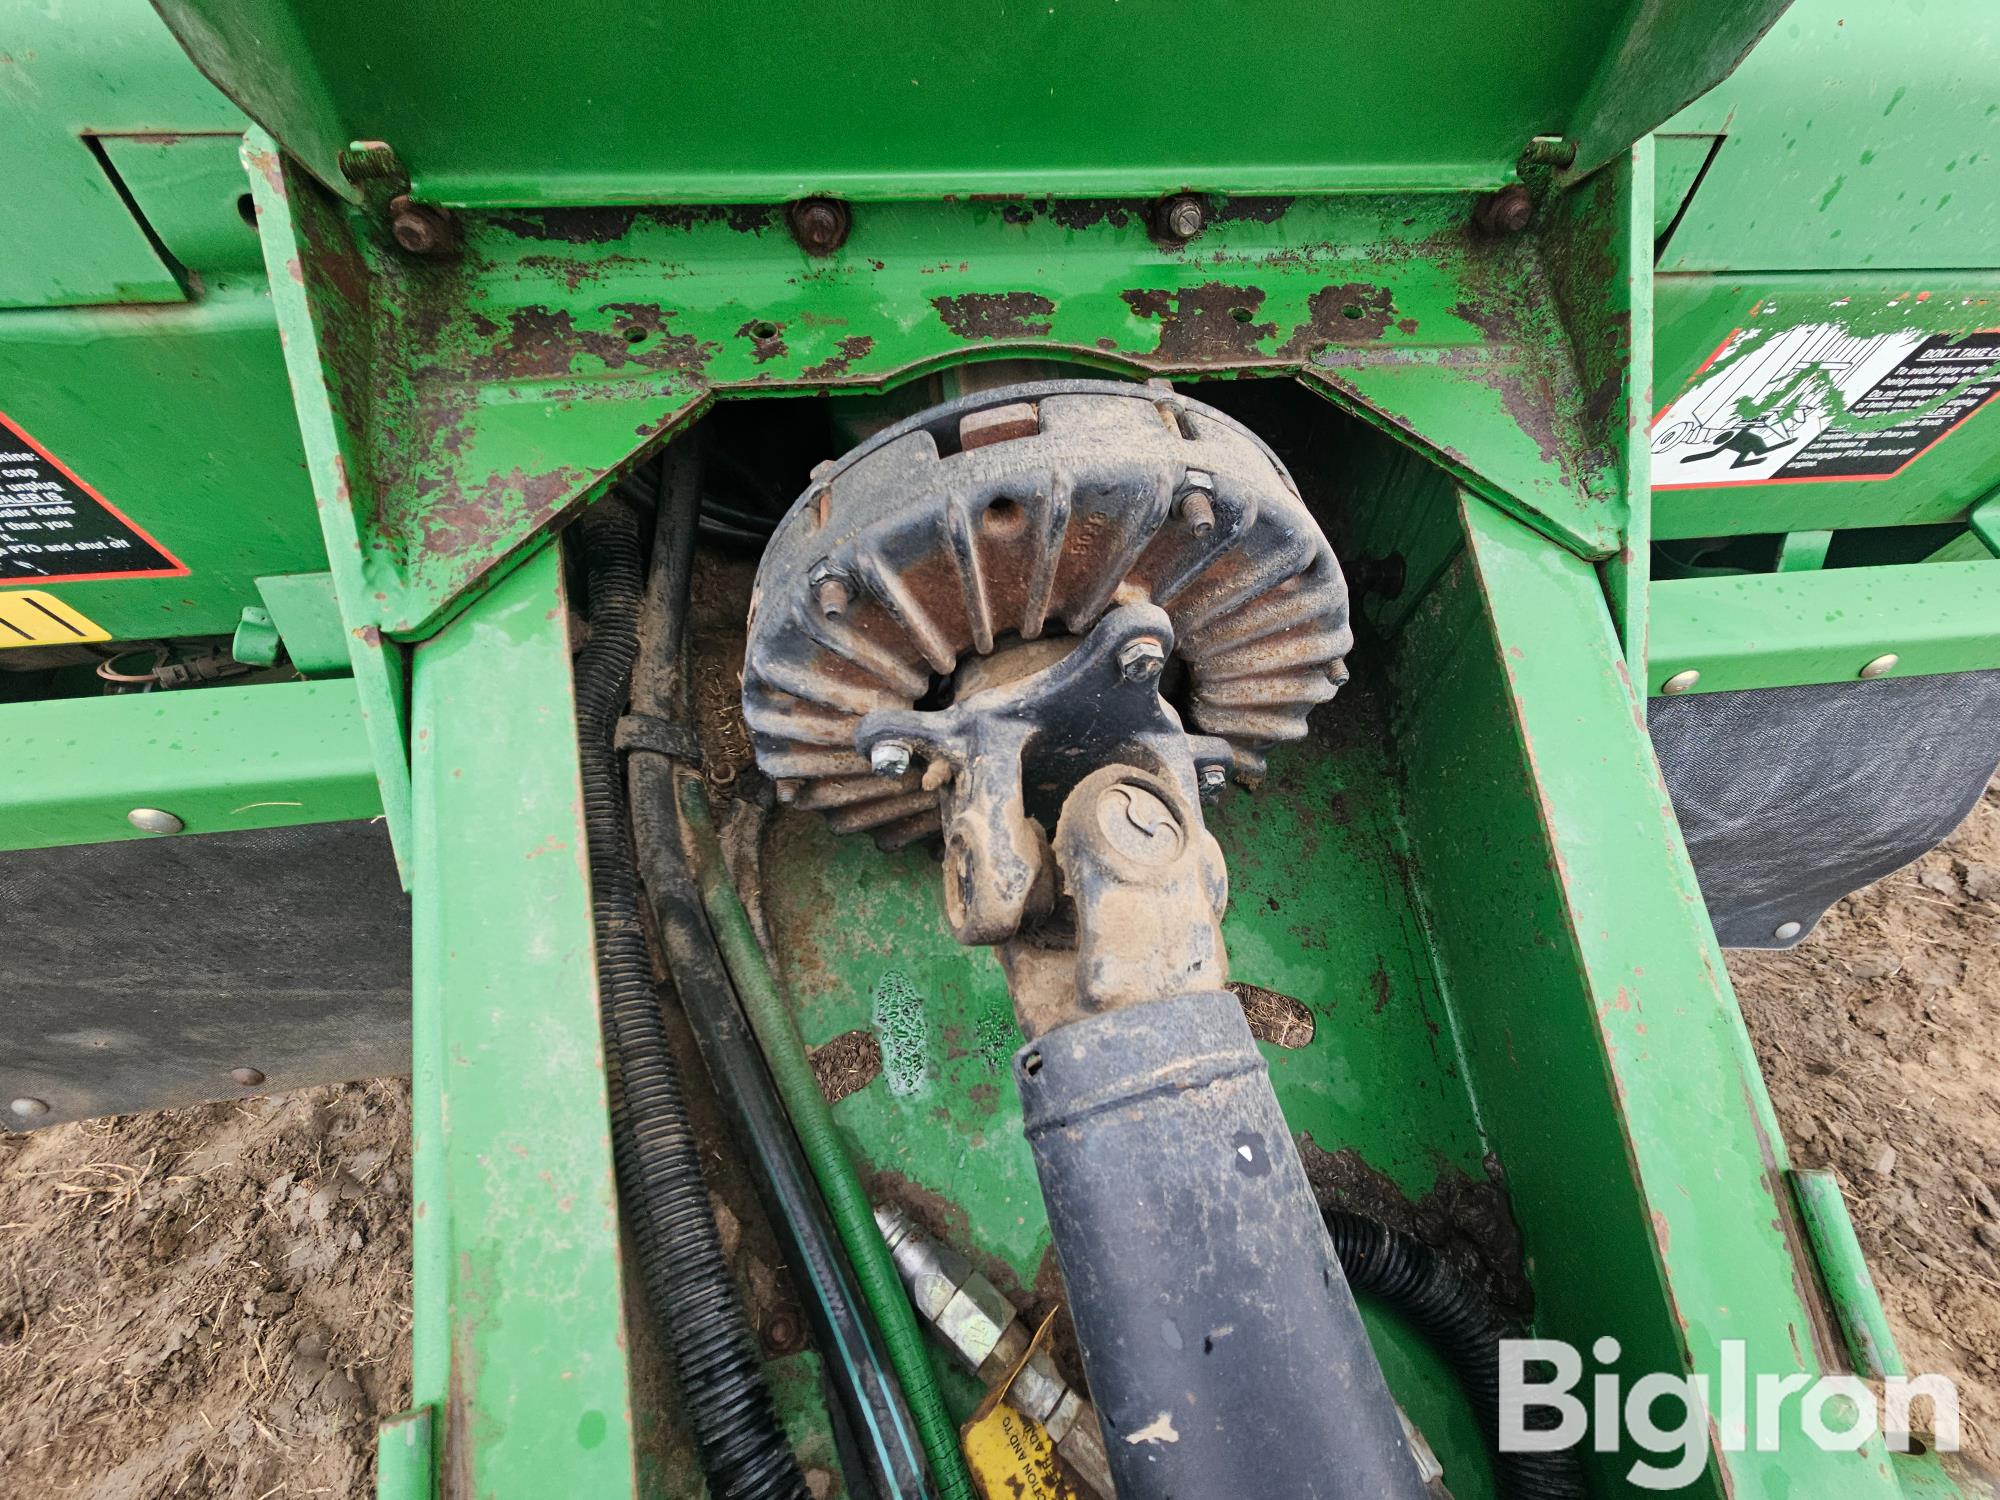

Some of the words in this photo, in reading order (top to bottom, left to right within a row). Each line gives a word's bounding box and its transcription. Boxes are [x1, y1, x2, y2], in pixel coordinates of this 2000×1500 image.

[1919, 348, 1961, 359] DON'T
[1958, 347, 1992, 358] TAKE
[1895, 366, 1910, 375] To
[1907, 366, 1938, 375] avoid
[1867, 389, 1884, 398] Do
[2, 468, 39, 479] crop
[6, 480, 66, 493] unplug
[0, 493, 45, 505] ALER
[42, 491, 64, 502] IS
[31, 505, 76, 516] feeds
[5, 521, 43, 531] than
[42, 520, 74, 531] you
[7, 543, 43, 554] PTO
[44, 542, 75, 552] and
[75, 541, 109, 551] shut
[109, 539, 131, 549] off
[1002, 1416, 1015, 1436] TO
[1010, 1434, 1027, 1461] AND
